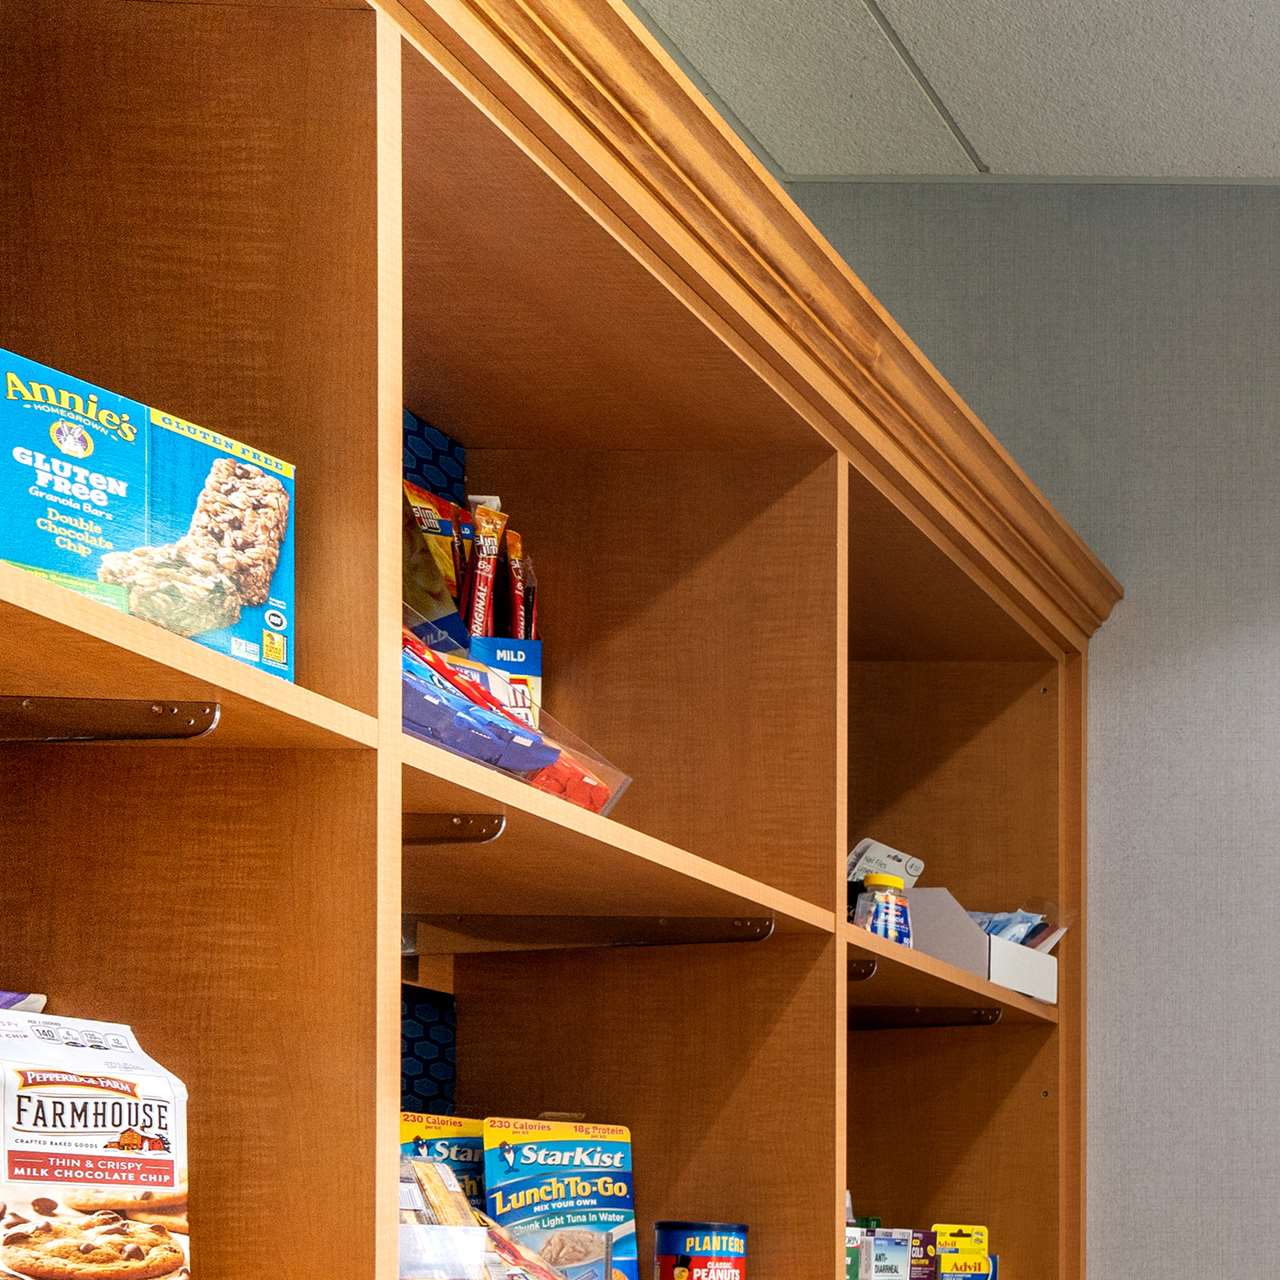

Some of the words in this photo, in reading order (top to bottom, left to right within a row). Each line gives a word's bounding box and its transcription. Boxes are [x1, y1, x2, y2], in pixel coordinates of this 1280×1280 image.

[6, 372, 137, 442] Annie's
[34, 403, 108, 435] HOMEGROWN
[162, 415, 233, 450] GLUTEN
[241, 447, 283, 471] FREE
[28, 486, 80, 510] Granola
[82, 502, 113, 520] Bars
[47, 508, 102, 534] Double
[36, 517, 113, 549] Chocolate
[55, 536, 92, 557] Chip
[496, 650, 525, 662] MILD
[35, 1029, 55, 1039] 140
[27, 1072, 97, 1085] PEPPERIDGE
[100, 1077, 130, 1093] FARM
[16, 1095, 167, 1130] FARMHOUSE
[403, 1114, 423, 1123] 230
[426, 1116, 462, 1127] Calories
[489, 1120, 510, 1128] 230
[513, 1121, 551, 1131] Calories
[574, 1125, 590, 1135] 18g
[593, 1126, 624, 1135] Protein
[48, 1158, 82, 1167] THIN
[85, 1159, 94, 1168] &
[98, 1160, 143, 1171] CRISPY
[520, 1145, 624, 1167] StarKist
[14, 1167, 49, 1177] MILK
[54, 1169, 135, 1182] CHOCOLATE
[139, 1174, 170, 1183] CHIP
[490, 1179, 563, 1215] Lunch
[565, 1177, 627, 1200] To-Go
[534, 1203, 549, 1212] MIX
[551, 1201, 574, 1209] YOUR
[542, 1216, 563, 1228] Light
[565, 1215, 586, 1223] Tuna
[599, 1214, 624, 1222] Water
[685, 1236, 744, 1253] PLANTERS
[693, 1269, 740, 1280] PEANUTS
[951, 1262, 981, 1272] Advil
